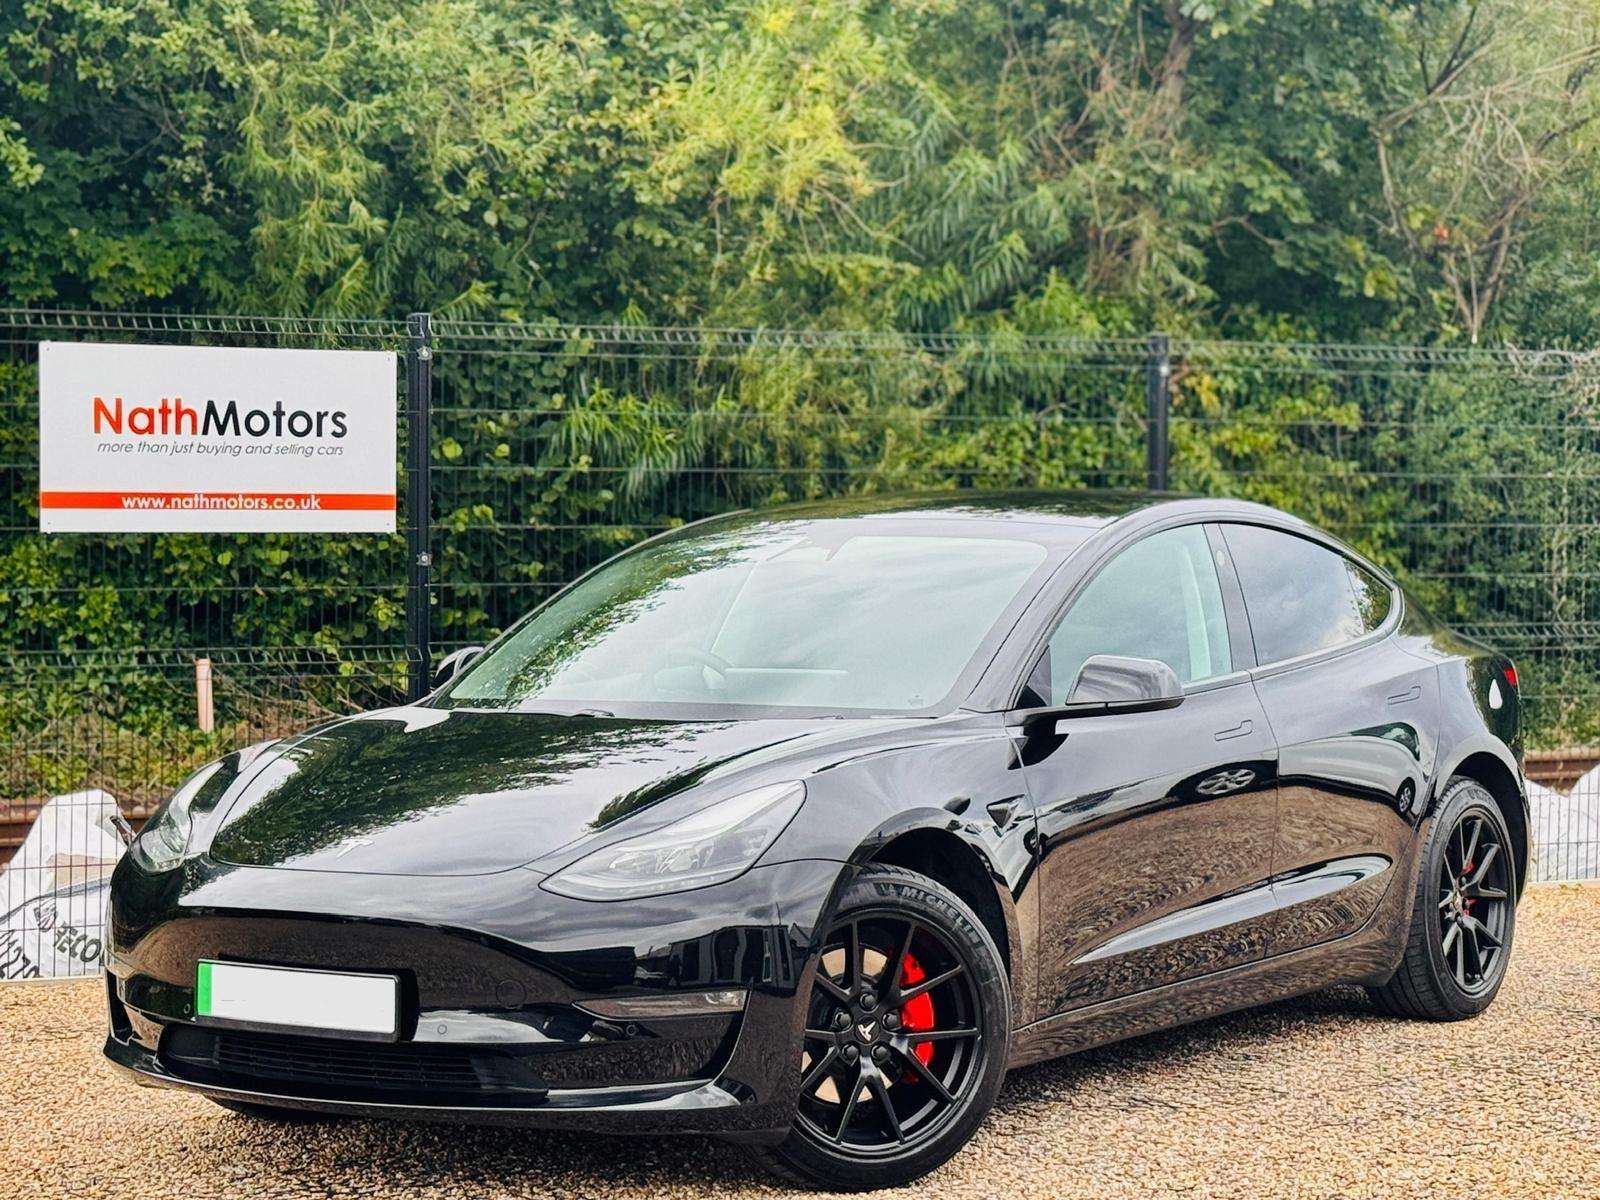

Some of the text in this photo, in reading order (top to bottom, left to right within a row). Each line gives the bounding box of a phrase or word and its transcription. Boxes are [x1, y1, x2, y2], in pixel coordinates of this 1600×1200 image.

[94, 397, 347, 438] NathMotors
[97, 441, 344, 458] more than just buying and selling cars
[121, 494, 321, 509] www.nathmotors.co.uk
